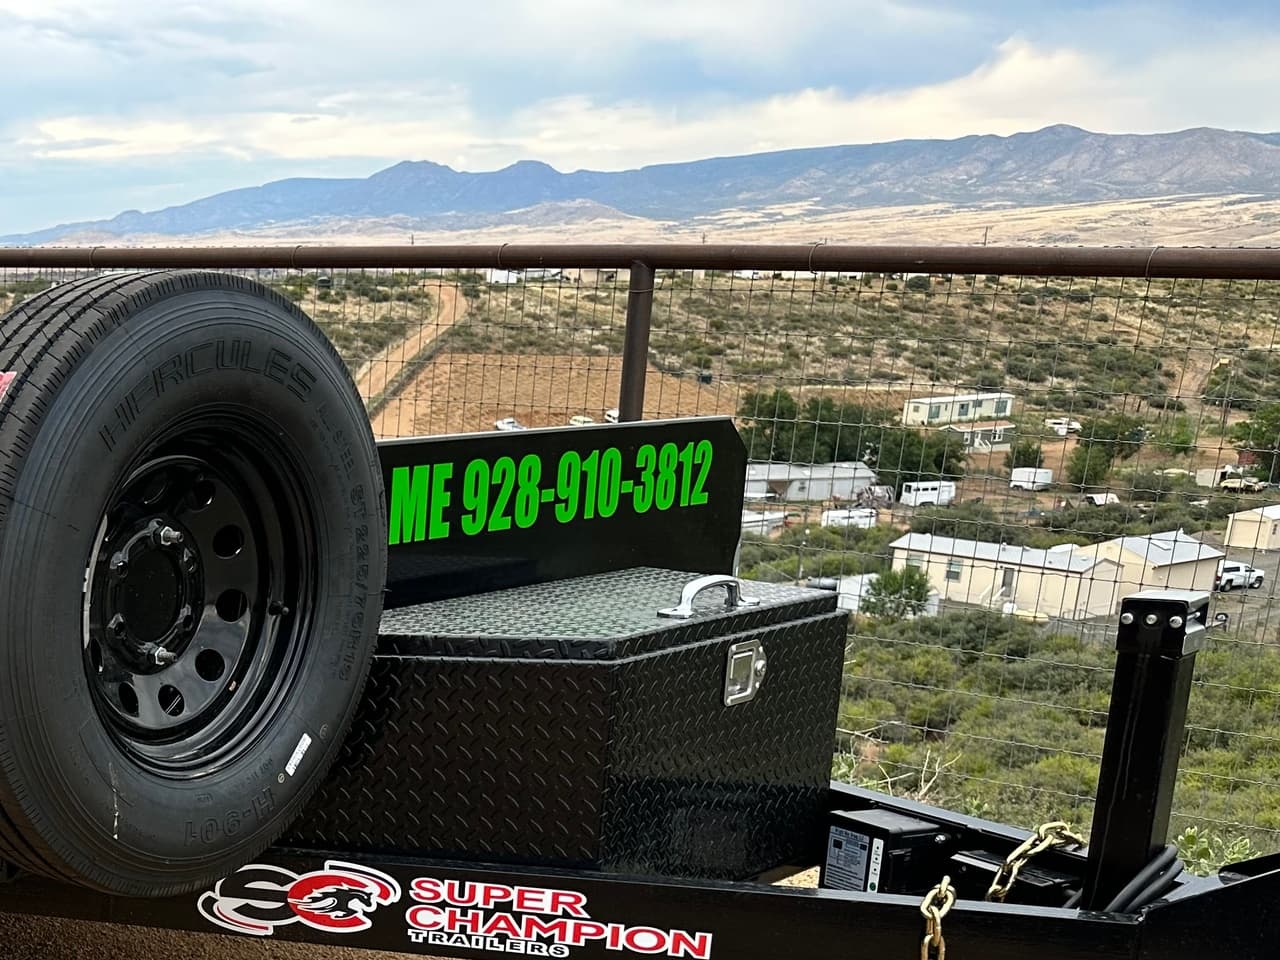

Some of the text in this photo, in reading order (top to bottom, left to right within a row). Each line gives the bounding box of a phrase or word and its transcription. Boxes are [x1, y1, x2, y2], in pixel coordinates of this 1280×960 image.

[98, 336, 318, 453] HERCULES
[388, 439, 714, 546] ME 928-910-3812
[409, 876, 591, 919] SUPER
[405, 905, 714, 960] CHAMPION
[407, 929, 571, 959] TRAILERS
